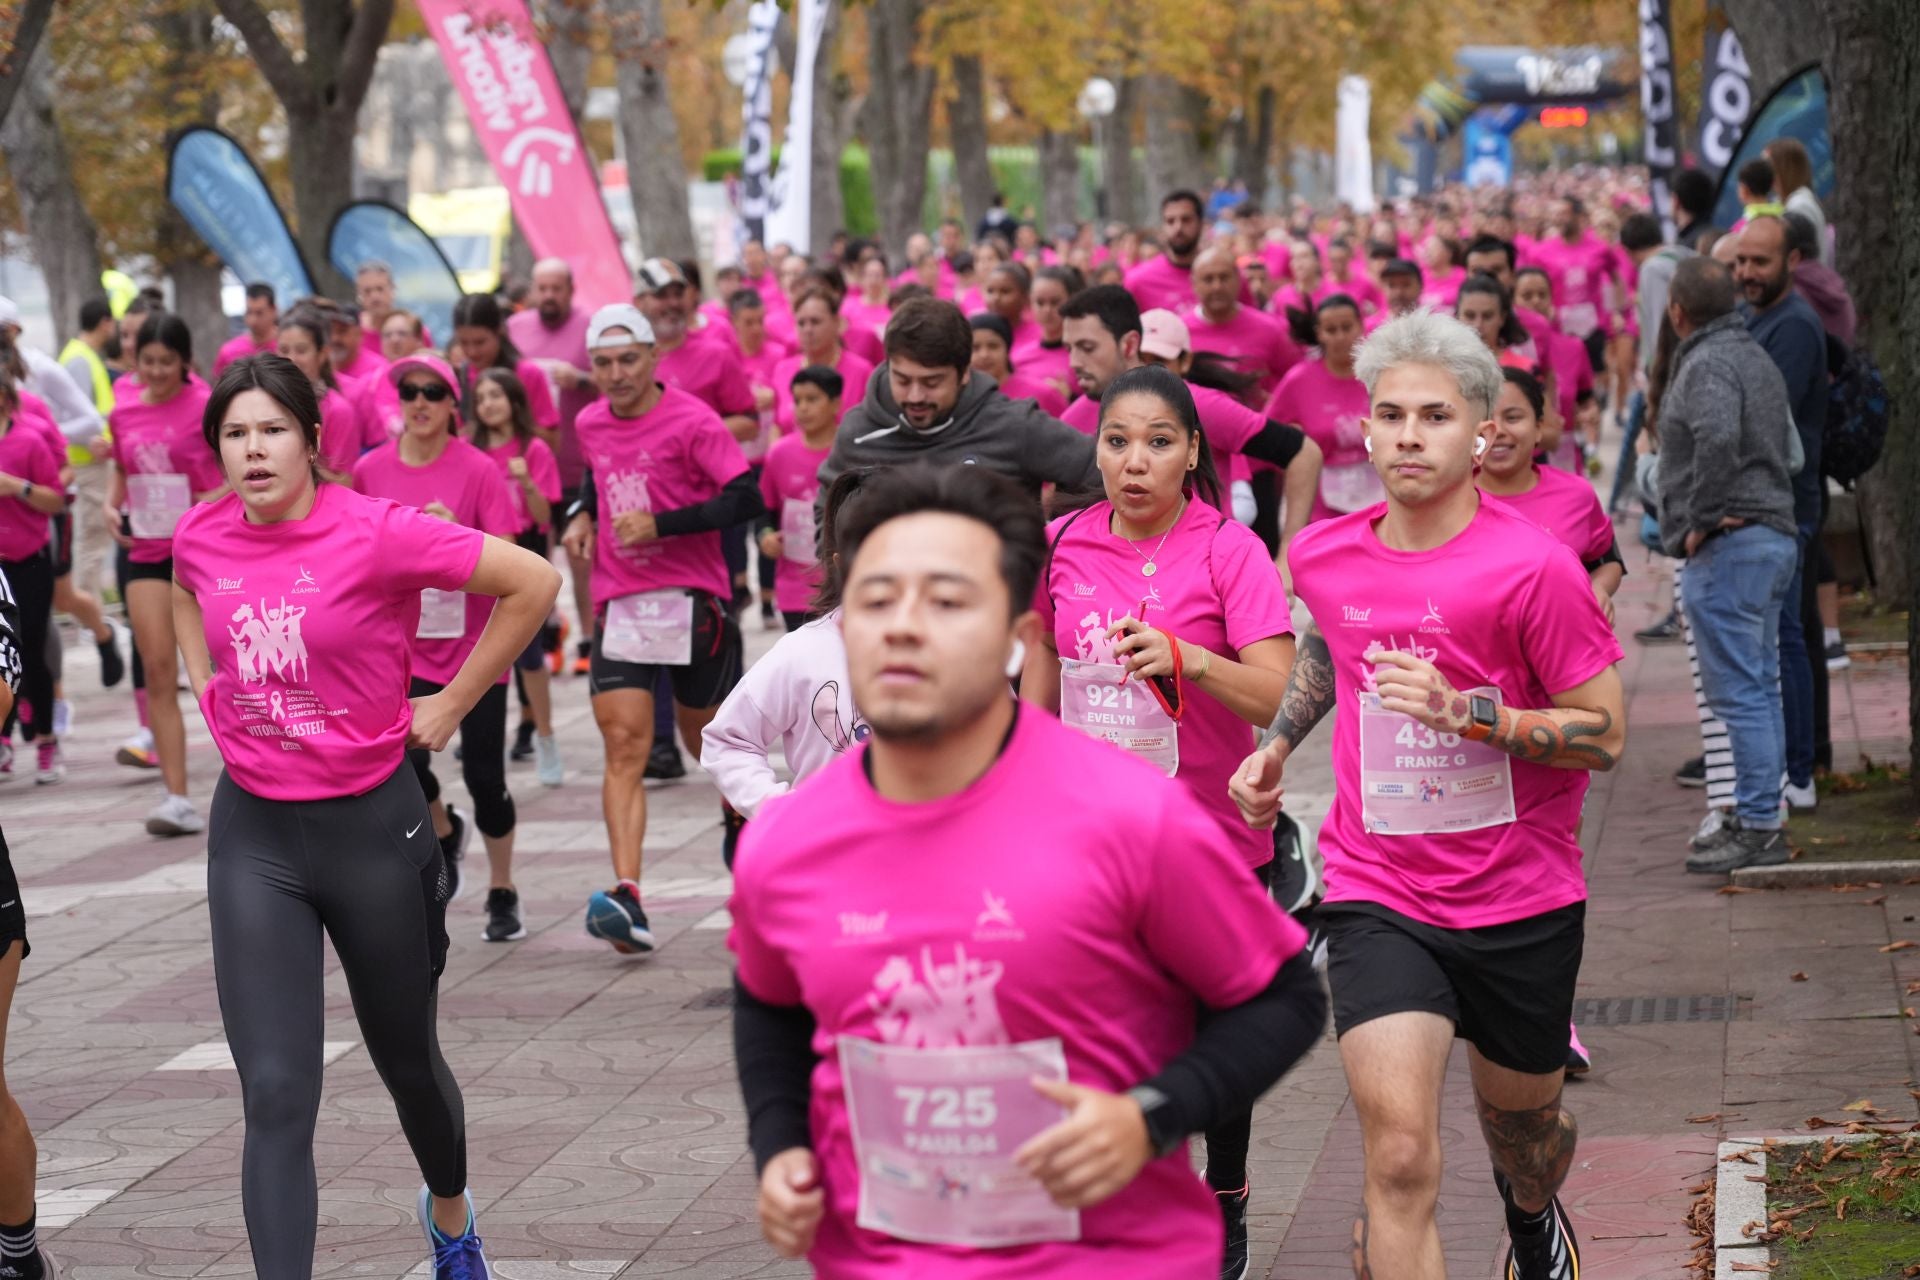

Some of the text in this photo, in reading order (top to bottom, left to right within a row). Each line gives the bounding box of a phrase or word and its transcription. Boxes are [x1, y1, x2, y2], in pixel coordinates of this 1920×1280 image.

[216, 578, 243, 590] Vital
[1073, 583, 1096, 596] Vital
[1342, 606, 1371, 621] Vital
[1086, 684, 1133, 710] 921
[287, 702, 316, 711] CONTRA
[1087, 711, 1136, 726] EVELYN
[1395, 753, 1467, 768] FRANZ G
[894, 1085, 999, 1128] 725
